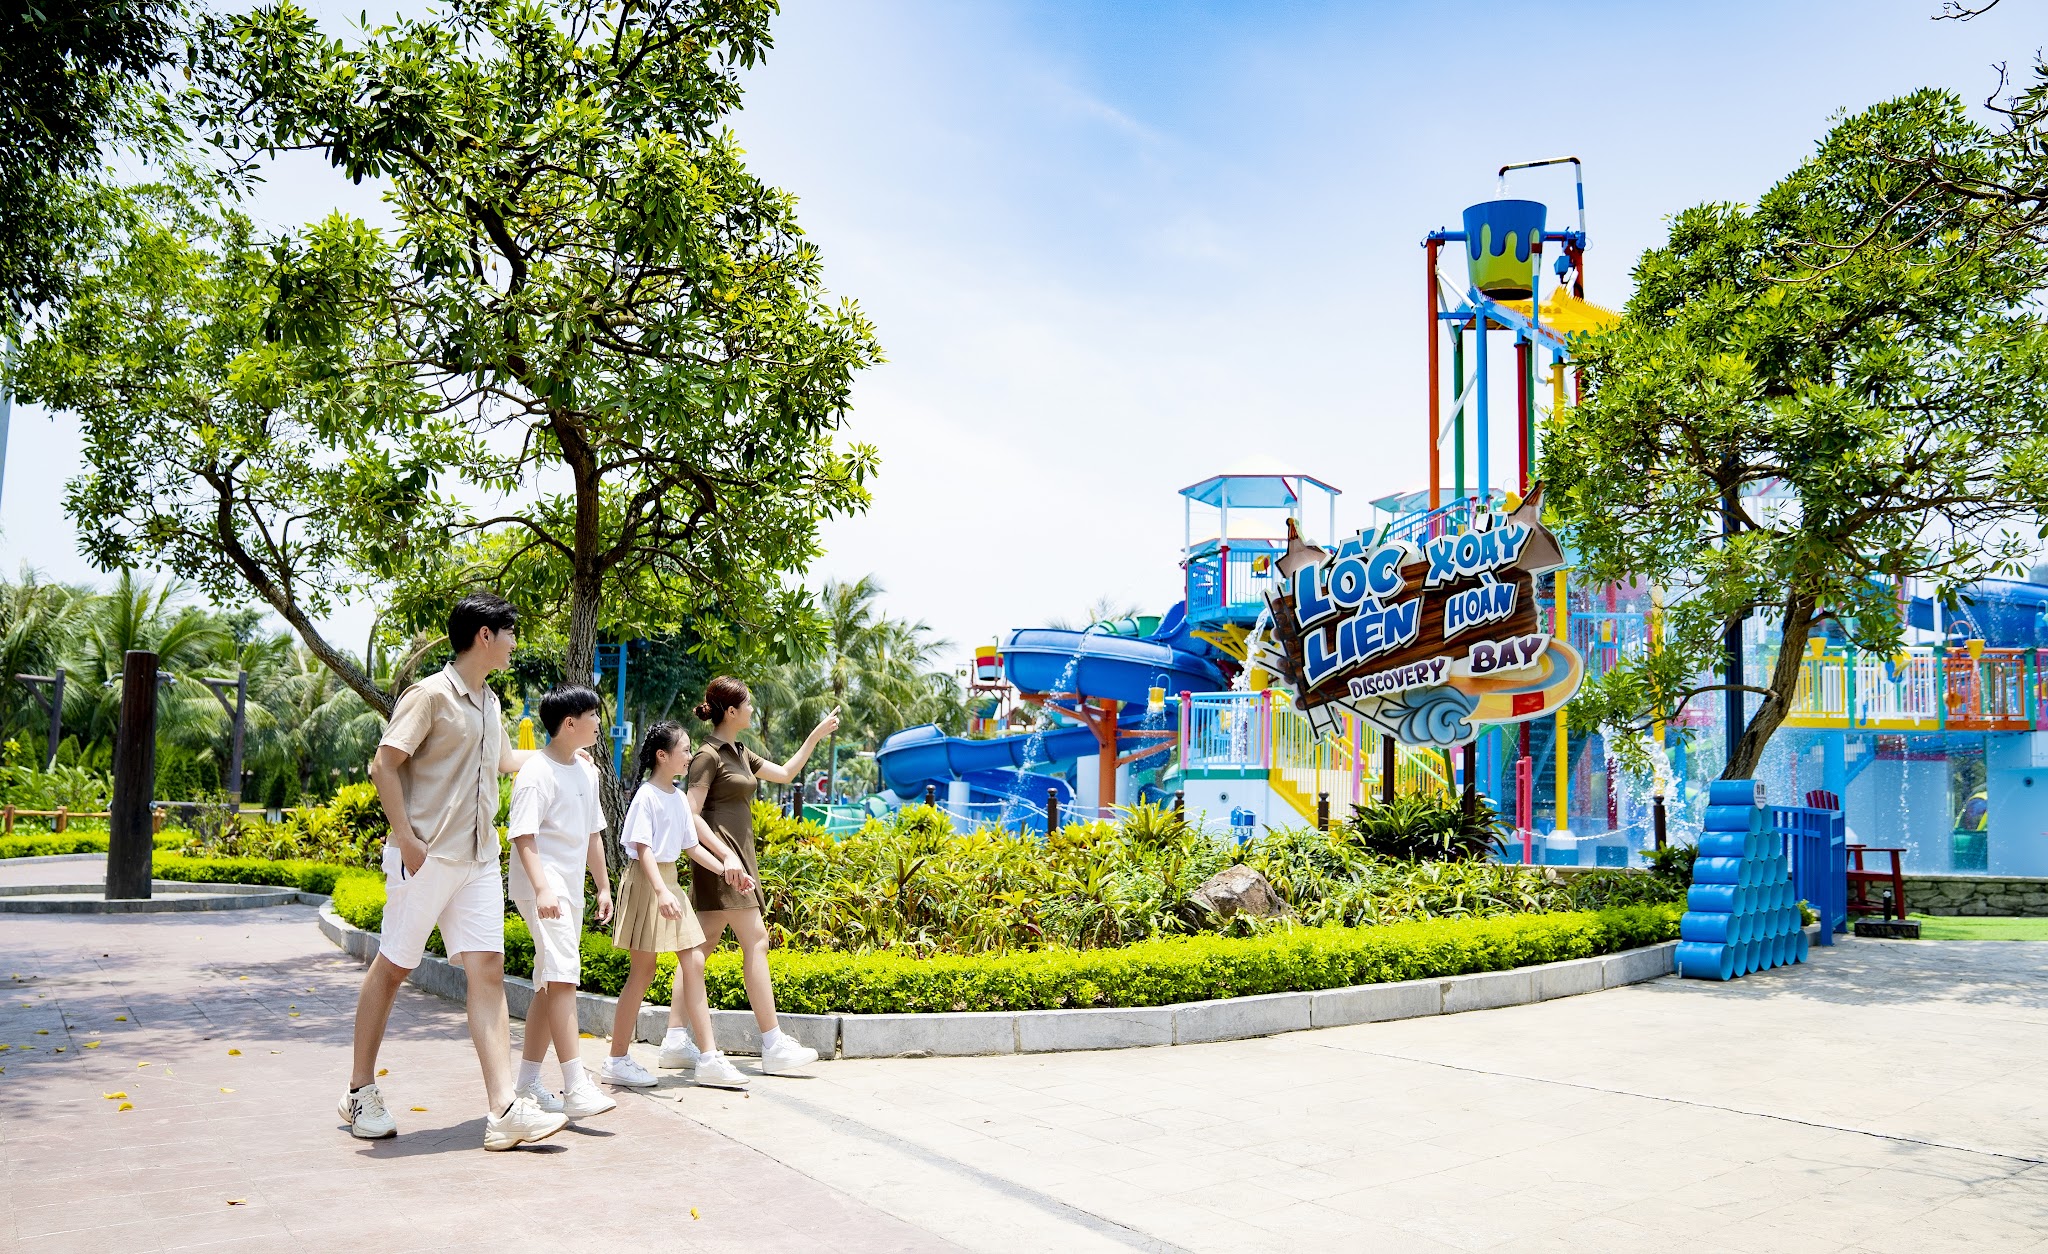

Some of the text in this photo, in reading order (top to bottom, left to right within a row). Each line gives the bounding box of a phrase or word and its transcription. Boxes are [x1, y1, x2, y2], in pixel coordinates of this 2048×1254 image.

[1298, 514, 1525, 625] LỐC XOÁY
[1307, 574, 1516, 682] LIÊN HOÀN
[1350, 637, 1543, 699] DISCOVERY BAY
